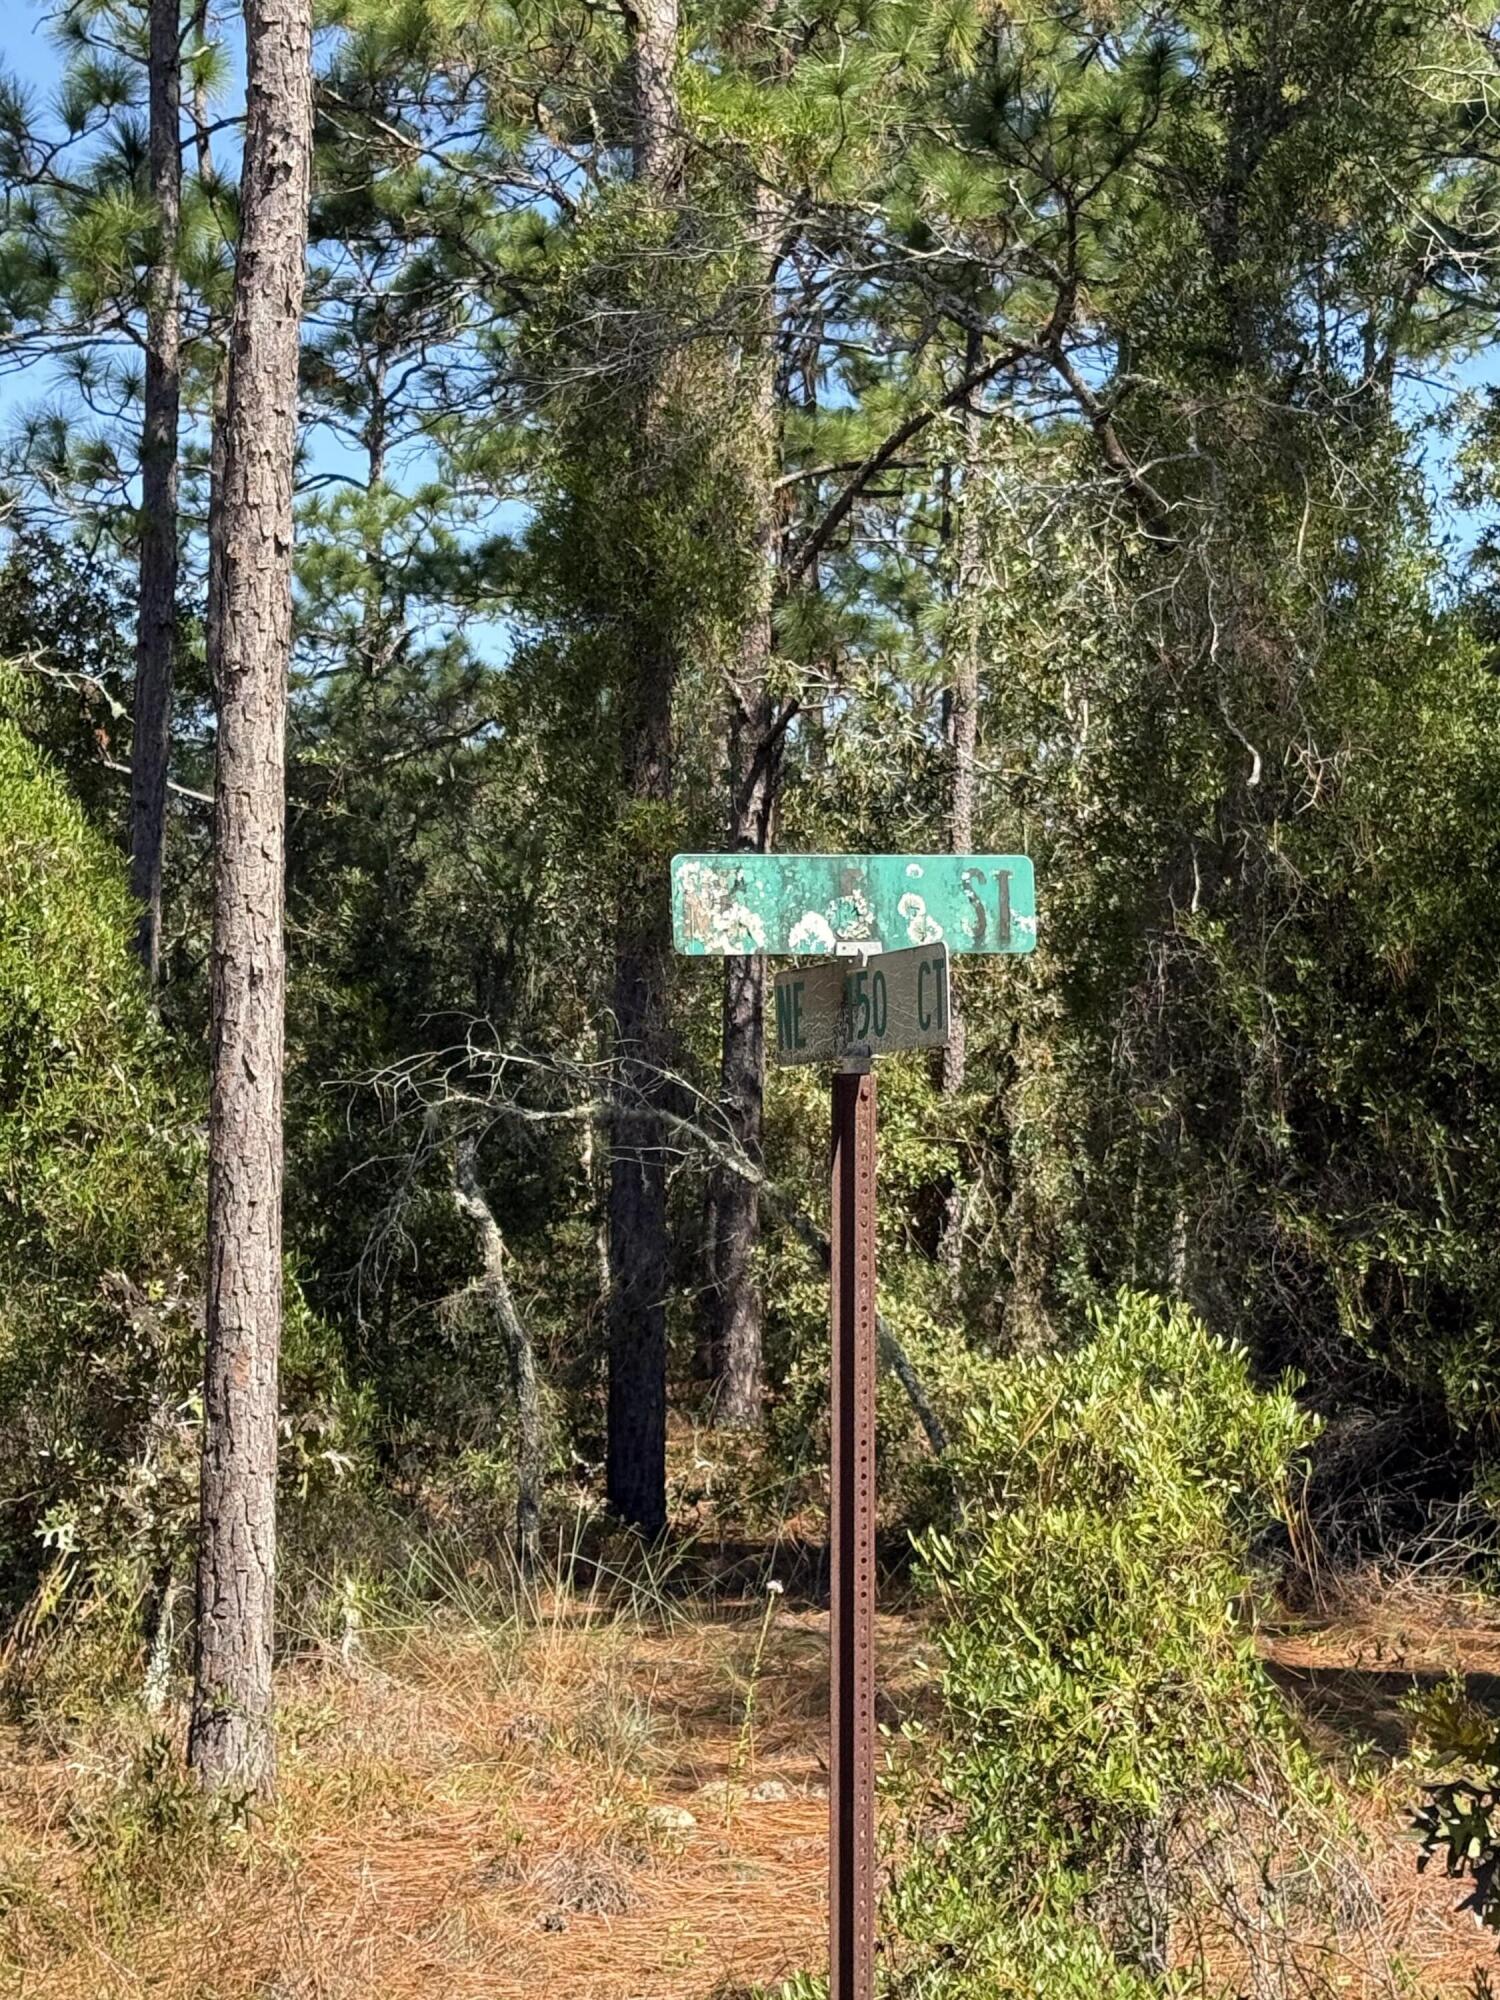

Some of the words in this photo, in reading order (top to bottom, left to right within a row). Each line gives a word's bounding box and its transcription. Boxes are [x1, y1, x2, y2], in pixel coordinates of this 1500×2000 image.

[961, 867, 1013, 949] ST
[776, 981, 806, 1050] NE
[917, 958, 945, 1031] CT
